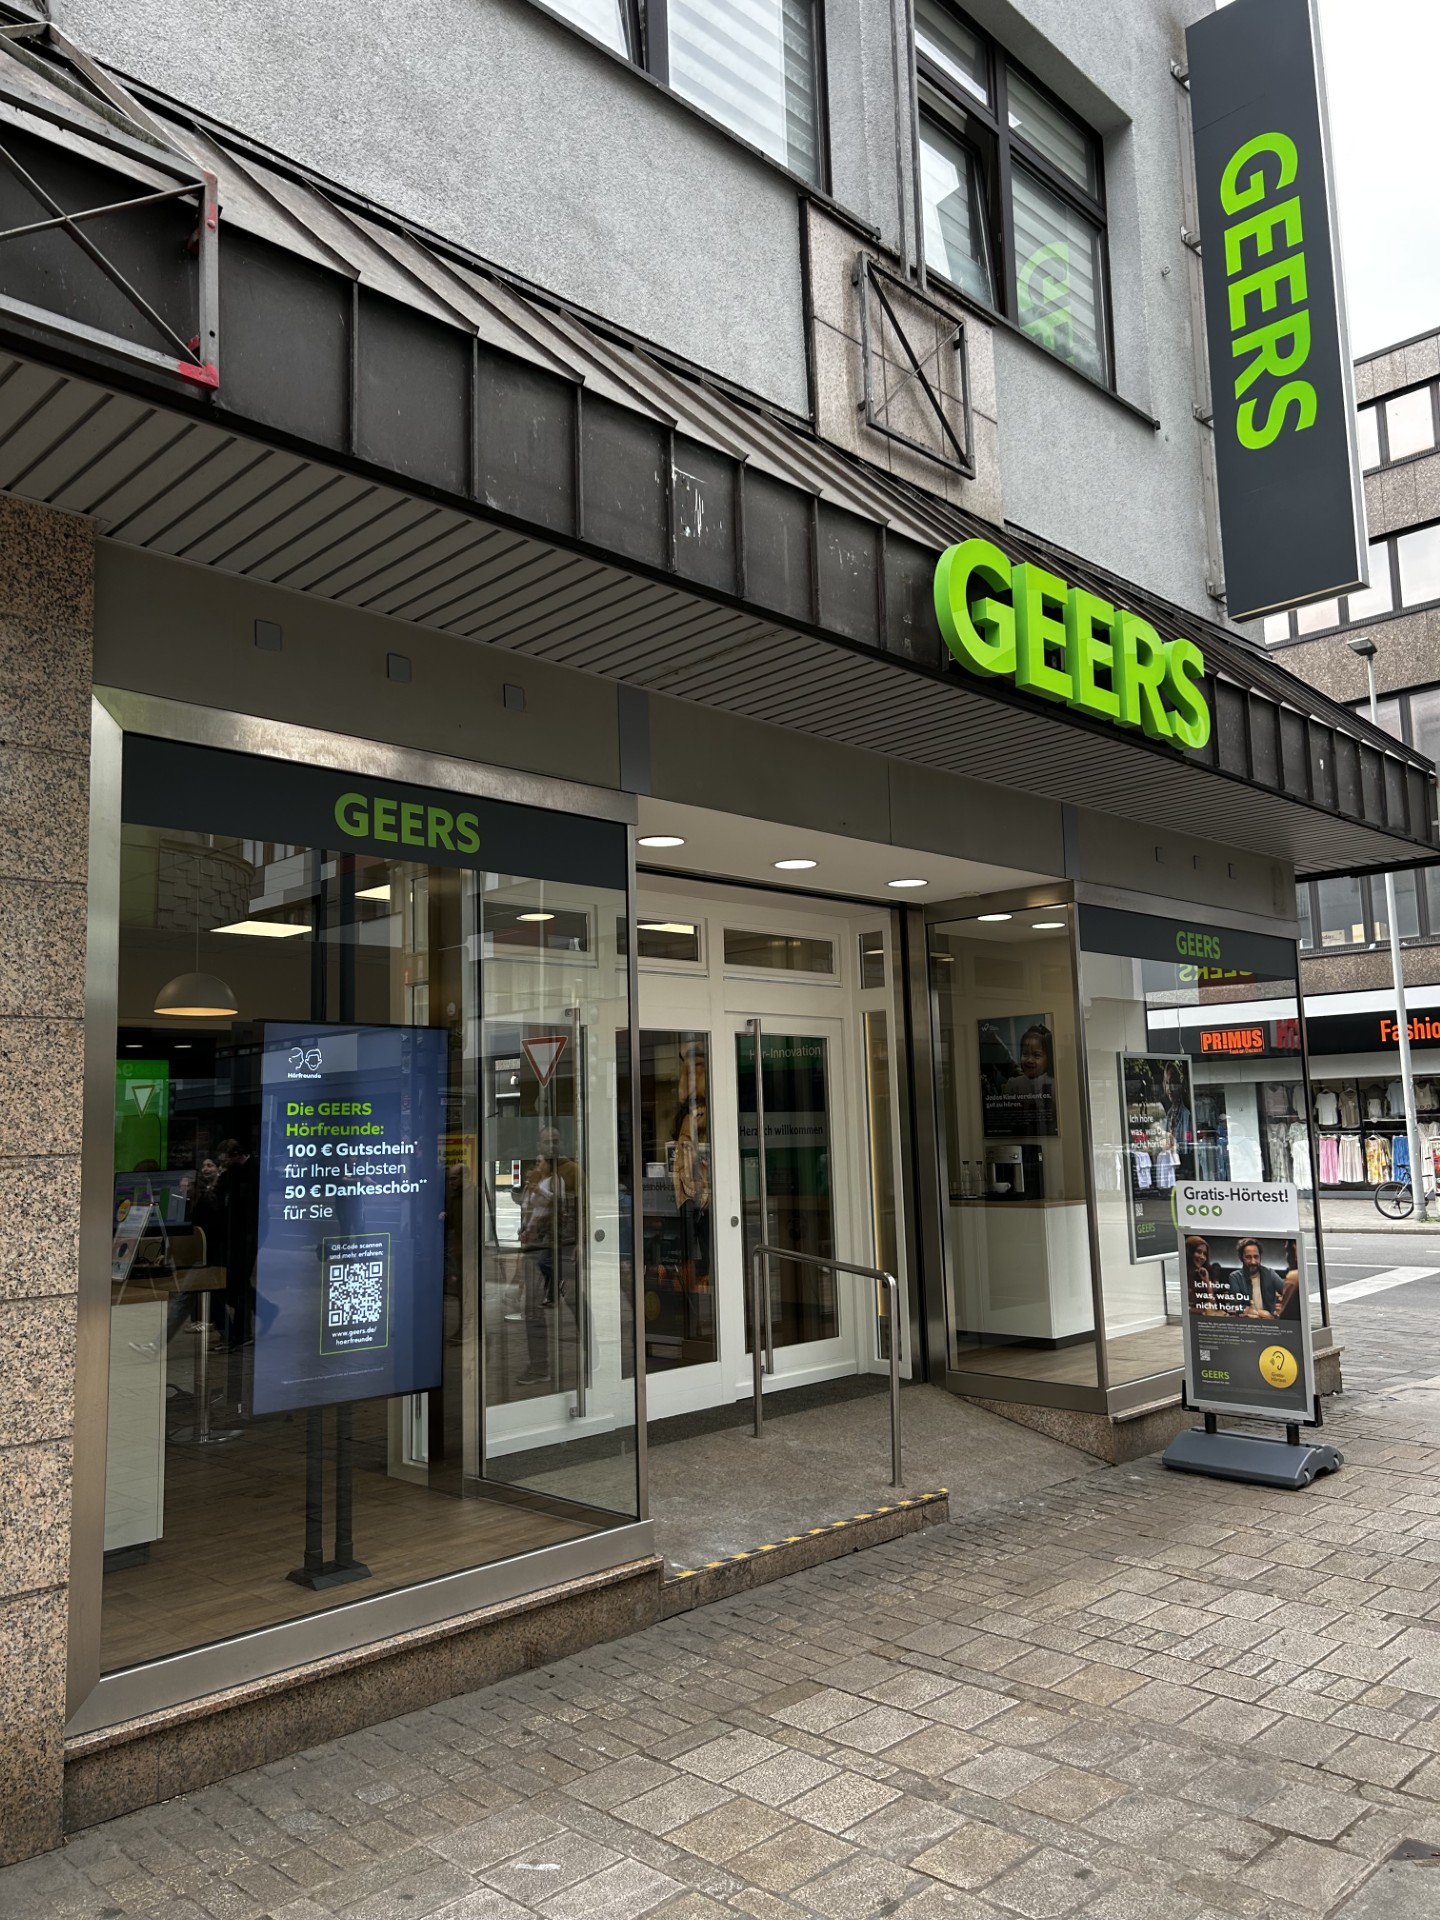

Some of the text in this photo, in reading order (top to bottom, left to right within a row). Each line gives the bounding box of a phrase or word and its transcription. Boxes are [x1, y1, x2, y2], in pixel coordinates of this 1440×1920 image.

[1220, 132, 1318, 450] GEERS
[934, 538, 1211, 749] GEERS
[334, 793, 481, 854] GEERS
[1176, 931, 1221, 960] GEERS
[749, 1045, 820, 1060] Hr-Innovation
[286, 1102, 372, 1116] Die GEERS
[1129, 1113, 1153, 1123] Ich höre
[286, 1122, 384, 1137] Hörfreunde:
[740, 1124, 823, 1137] Herzch willkommen
[286, 1144, 316, 1157] 100
[321, 1143, 333, 1156] €
[284, 1162, 406, 1179] für Ihre Liebsten
[284, 1185, 306, 1199] 50
[309, 1184, 321, 1198] €
[1183, 1186, 1289, 1203] Gratis-Hörtest!
[283, 1204, 333, 1220] für Sie
[331, 1243, 358, 1251] QR-Code
[329, 1252, 341, 1260] und
[1194, 1280, 1231, 1289] Ich höre
[1195, 1292, 1215, 1301] was,
[1236, 1292, 1250, 1301] Du
[1196, 1302, 1218, 1310] nicht
[335, 1335, 373, 1345] hoerfreunde
[1201, 1369, 1230, 1380] GEERS
